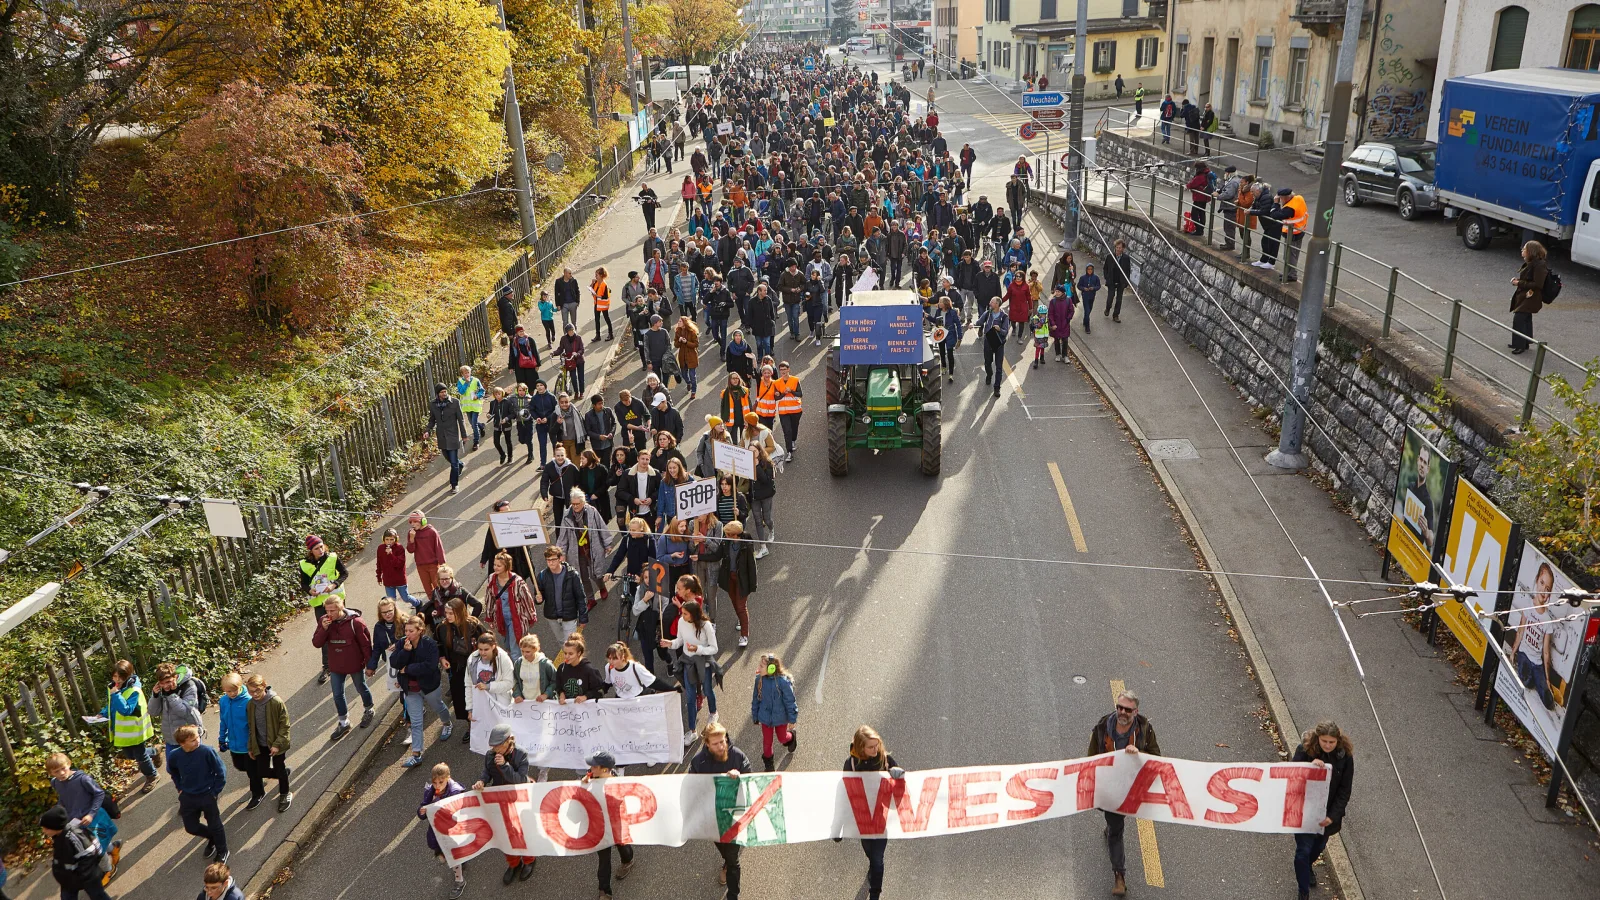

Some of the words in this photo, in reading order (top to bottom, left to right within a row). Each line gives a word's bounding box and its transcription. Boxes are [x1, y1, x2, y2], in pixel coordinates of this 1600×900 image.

[1030, 95, 1059, 104] Neuchâtel
[1485, 114, 1530, 136] VEREIN
[1480, 134, 1557, 162] FUNDAMENT
[1499, 157, 1518, 175] 541
[1522, 162, 1537, 179] 60
[1540, 166, 1556, 182] 92
[679, 484, 715, 510] STOP
[1405, 497, 1422, 523] OU
[1441, 511, 1502, 614] JA
[611, 705, 663, 716] unserem
[547, 722, 603, 739] Stadtkörper
[433, 782, 658, 861] STOP
